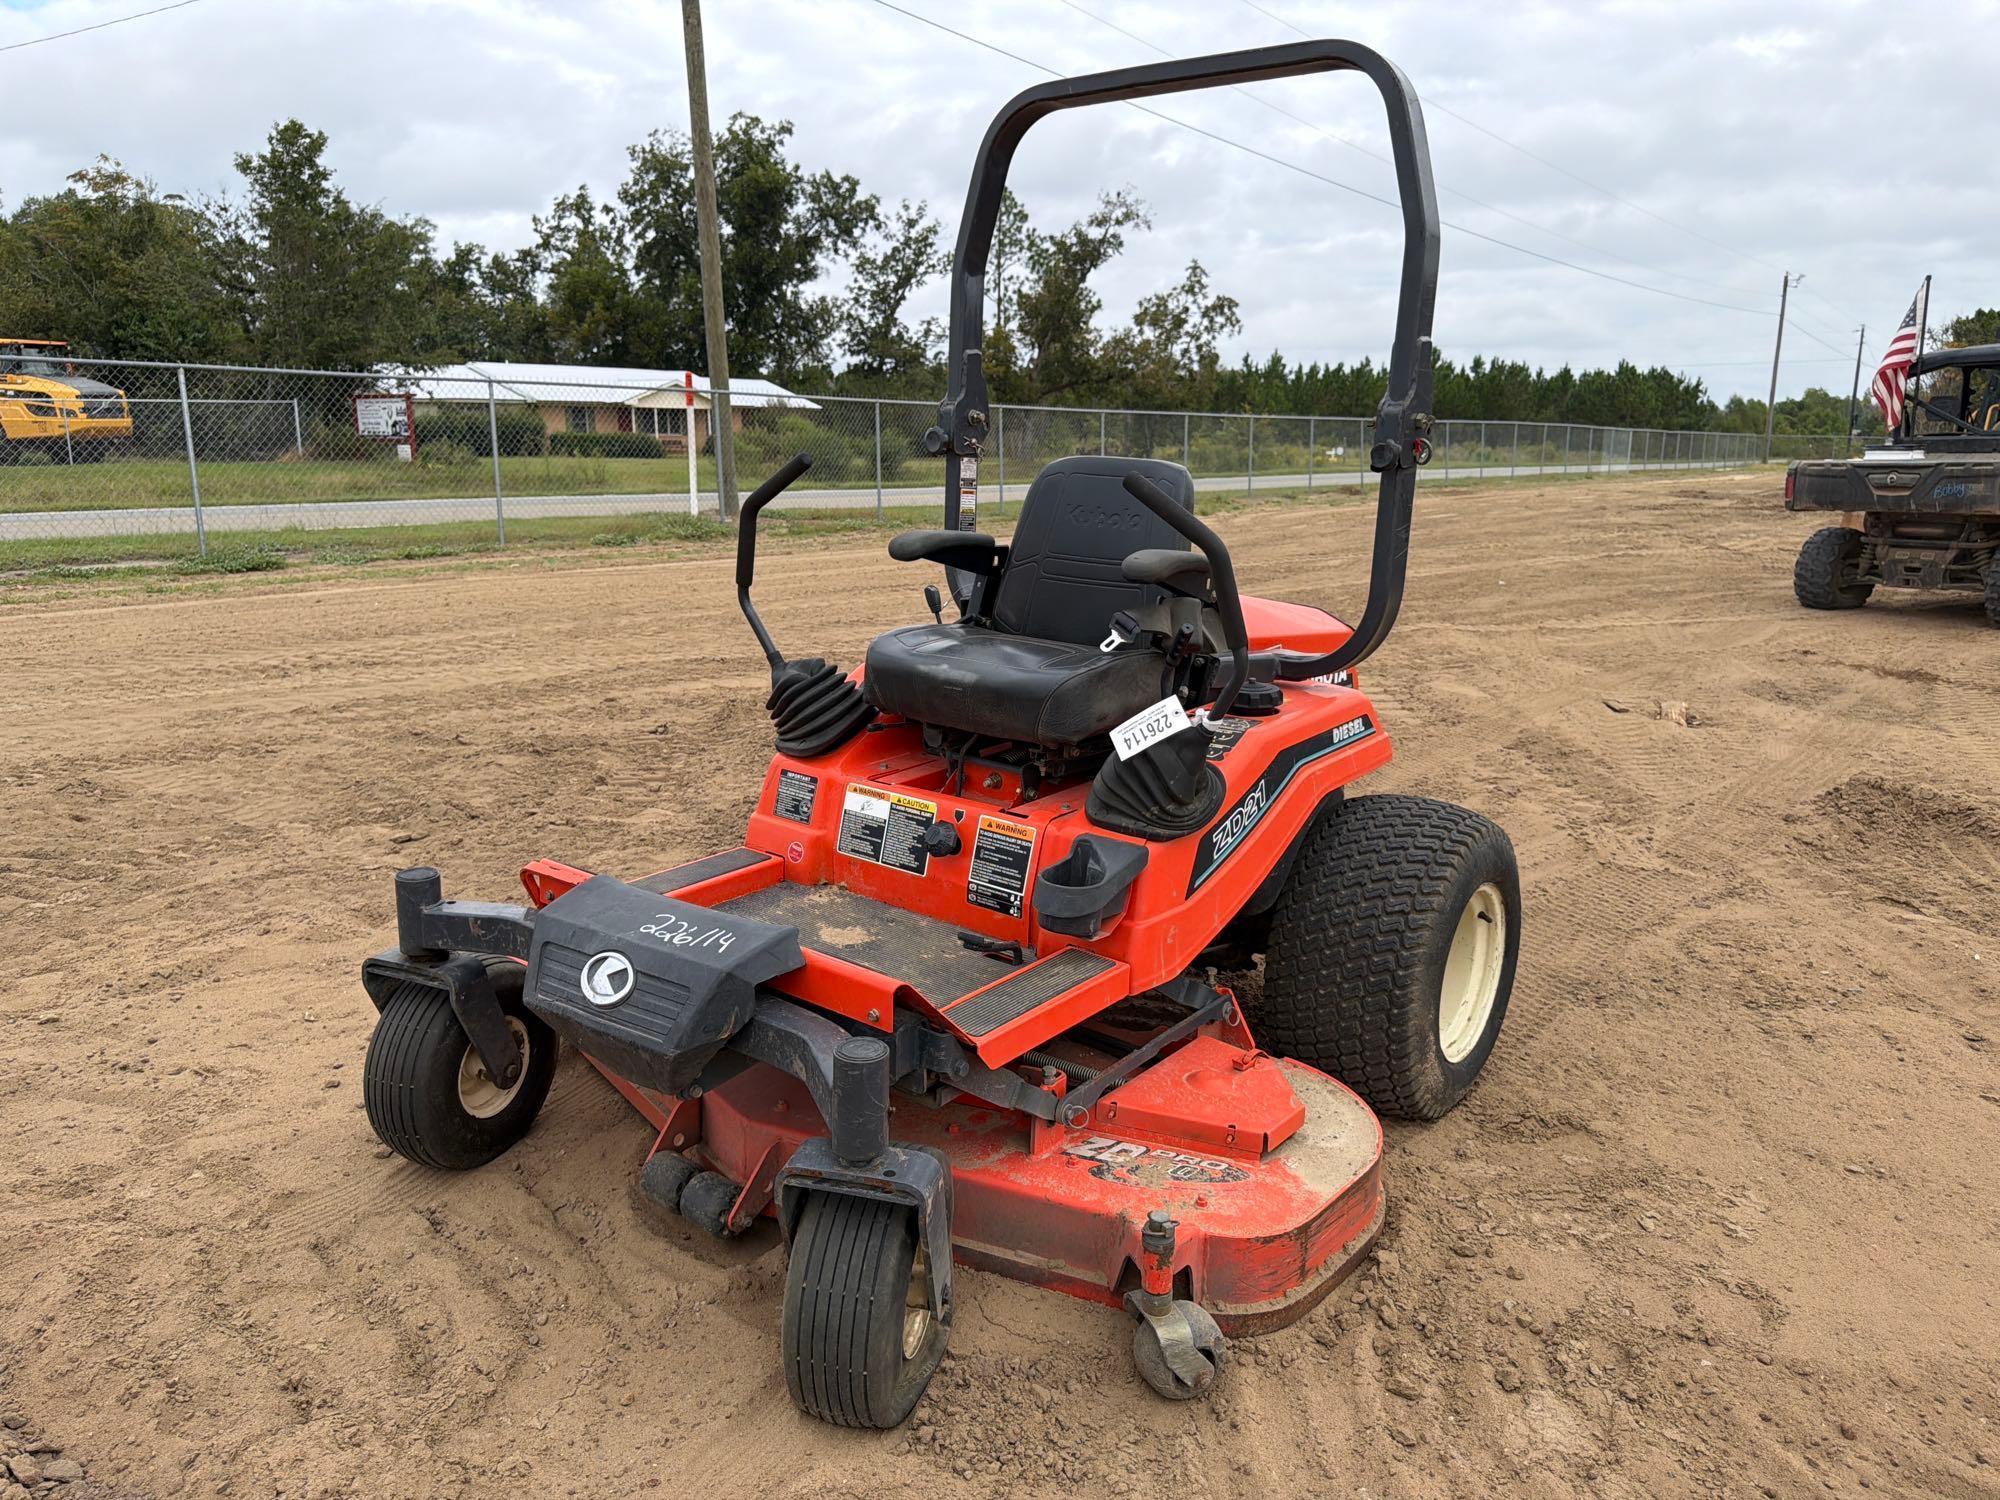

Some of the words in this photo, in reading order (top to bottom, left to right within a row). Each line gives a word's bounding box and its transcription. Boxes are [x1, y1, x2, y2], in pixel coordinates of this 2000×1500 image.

[1124, 714, 1173, 750] 226114
[1332, 717, 1365, 743] DIESEL
[858, 787, 886, 799] WARNING
[902, 798, 929, 810] CAUTION
[996, 823, 1027, 837] WARNING
[1212, 779, 1266, 860] ZD21
[1150, 1149, 1230, 1170] PRO
